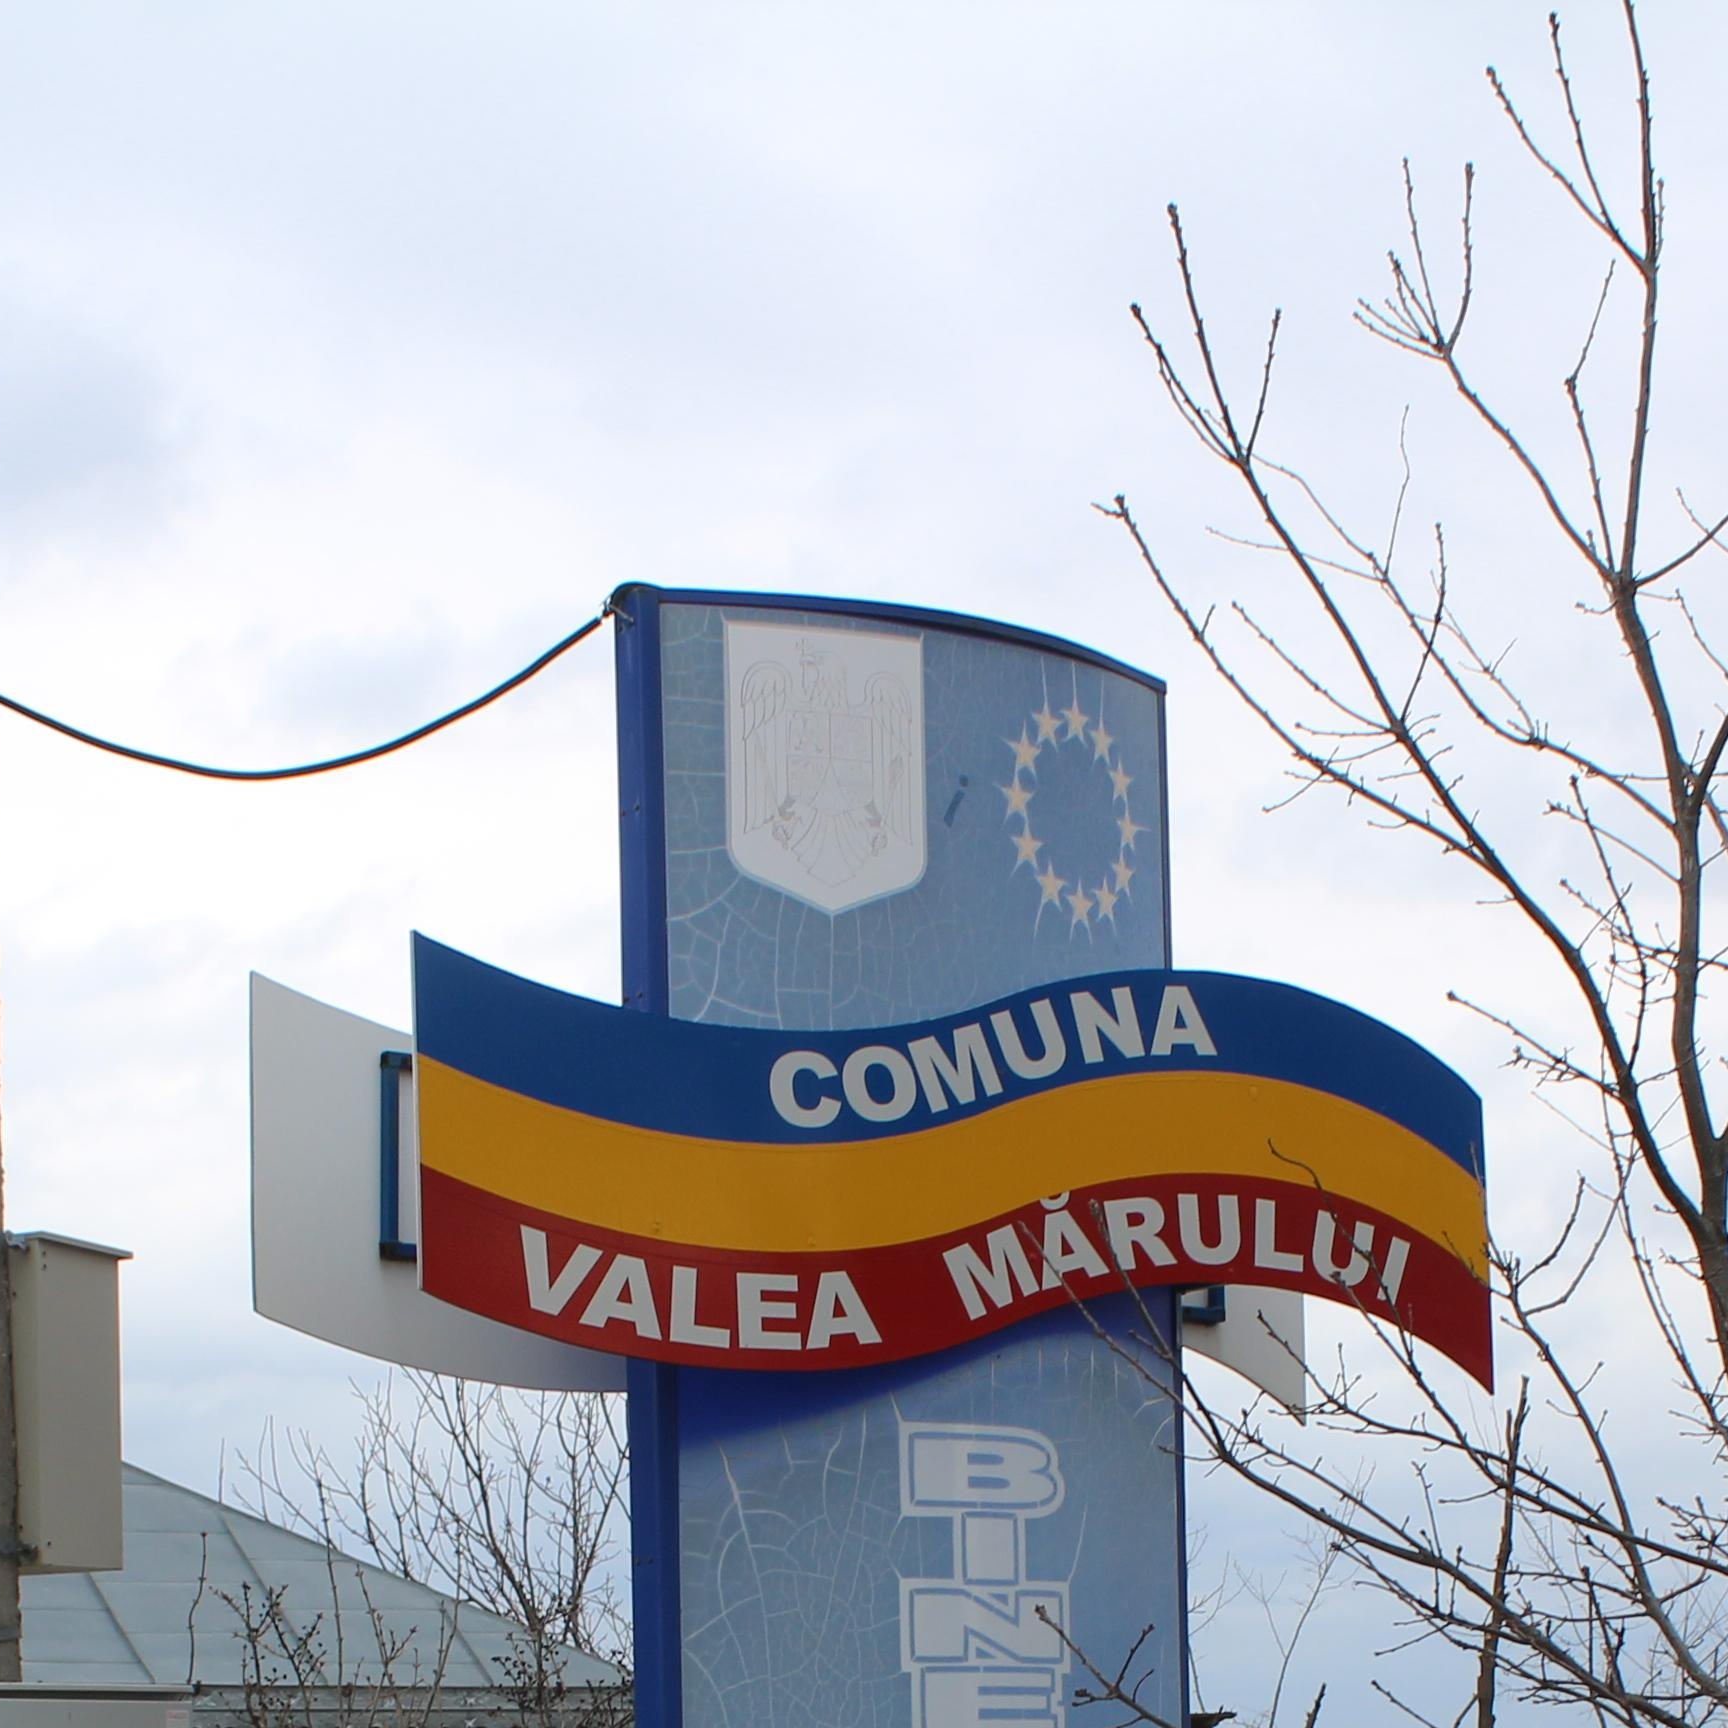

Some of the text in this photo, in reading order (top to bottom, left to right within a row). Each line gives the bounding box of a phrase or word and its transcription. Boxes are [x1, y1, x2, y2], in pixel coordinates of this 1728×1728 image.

[768, 984, 1218, 1129] COMUNA
[519, 1190, 1412, 1353] VALEA MĂRULUI
